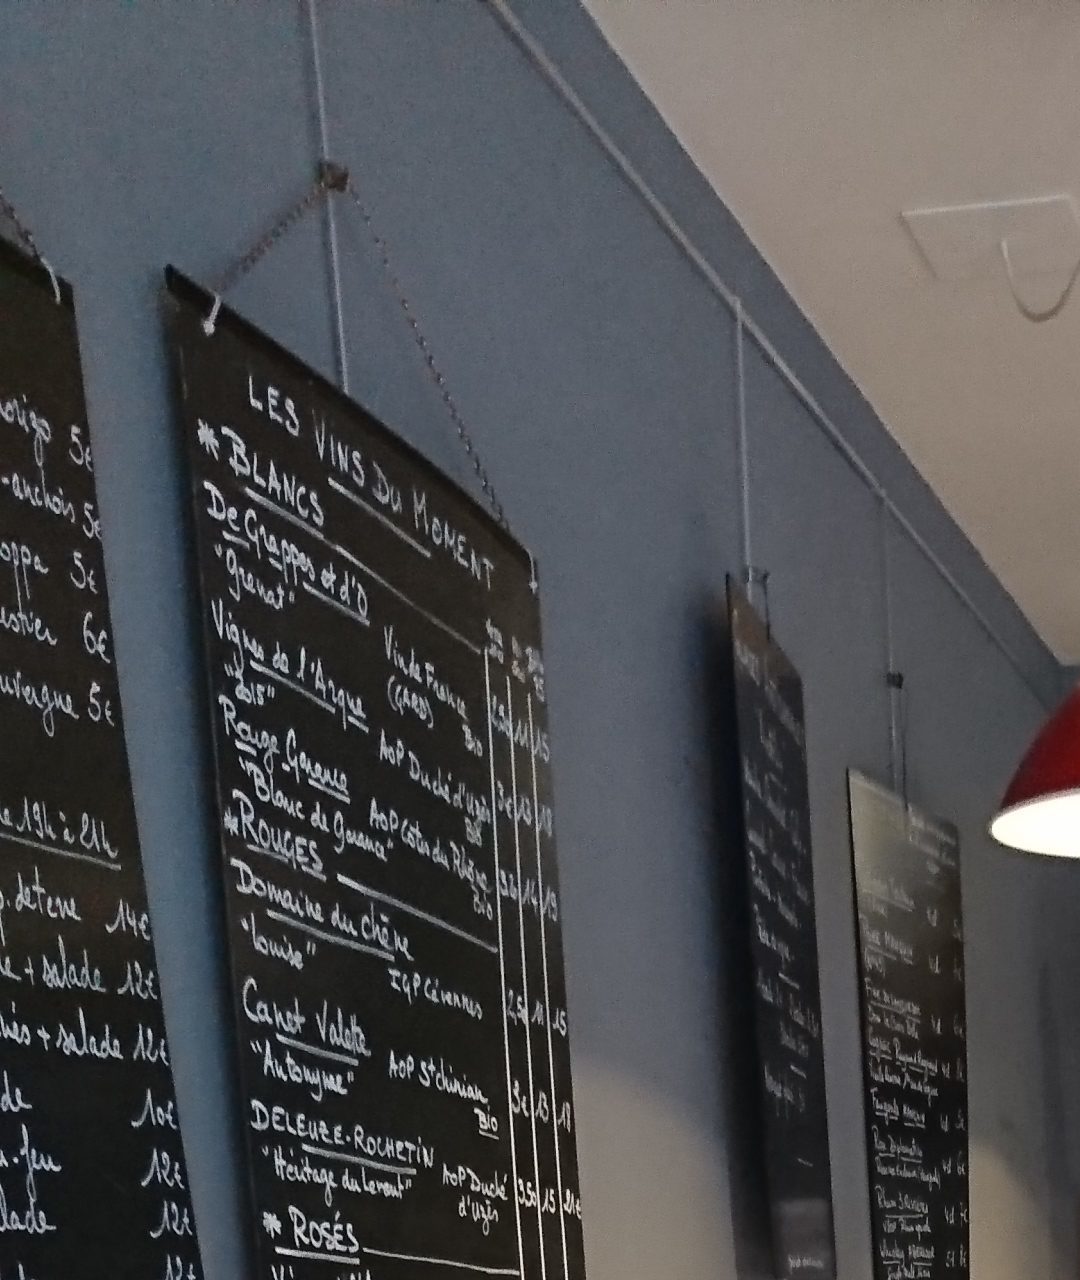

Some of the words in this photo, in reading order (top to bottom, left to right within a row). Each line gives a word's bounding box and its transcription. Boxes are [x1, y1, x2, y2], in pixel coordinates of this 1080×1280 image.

[249, 375, 299, 436] LES
[312, 409, 364, 487] VINS
[83, 611, 111, 664] 6€
[88, 681, 115, 727] 5€
[230, 857, 325, 923] Domaine
